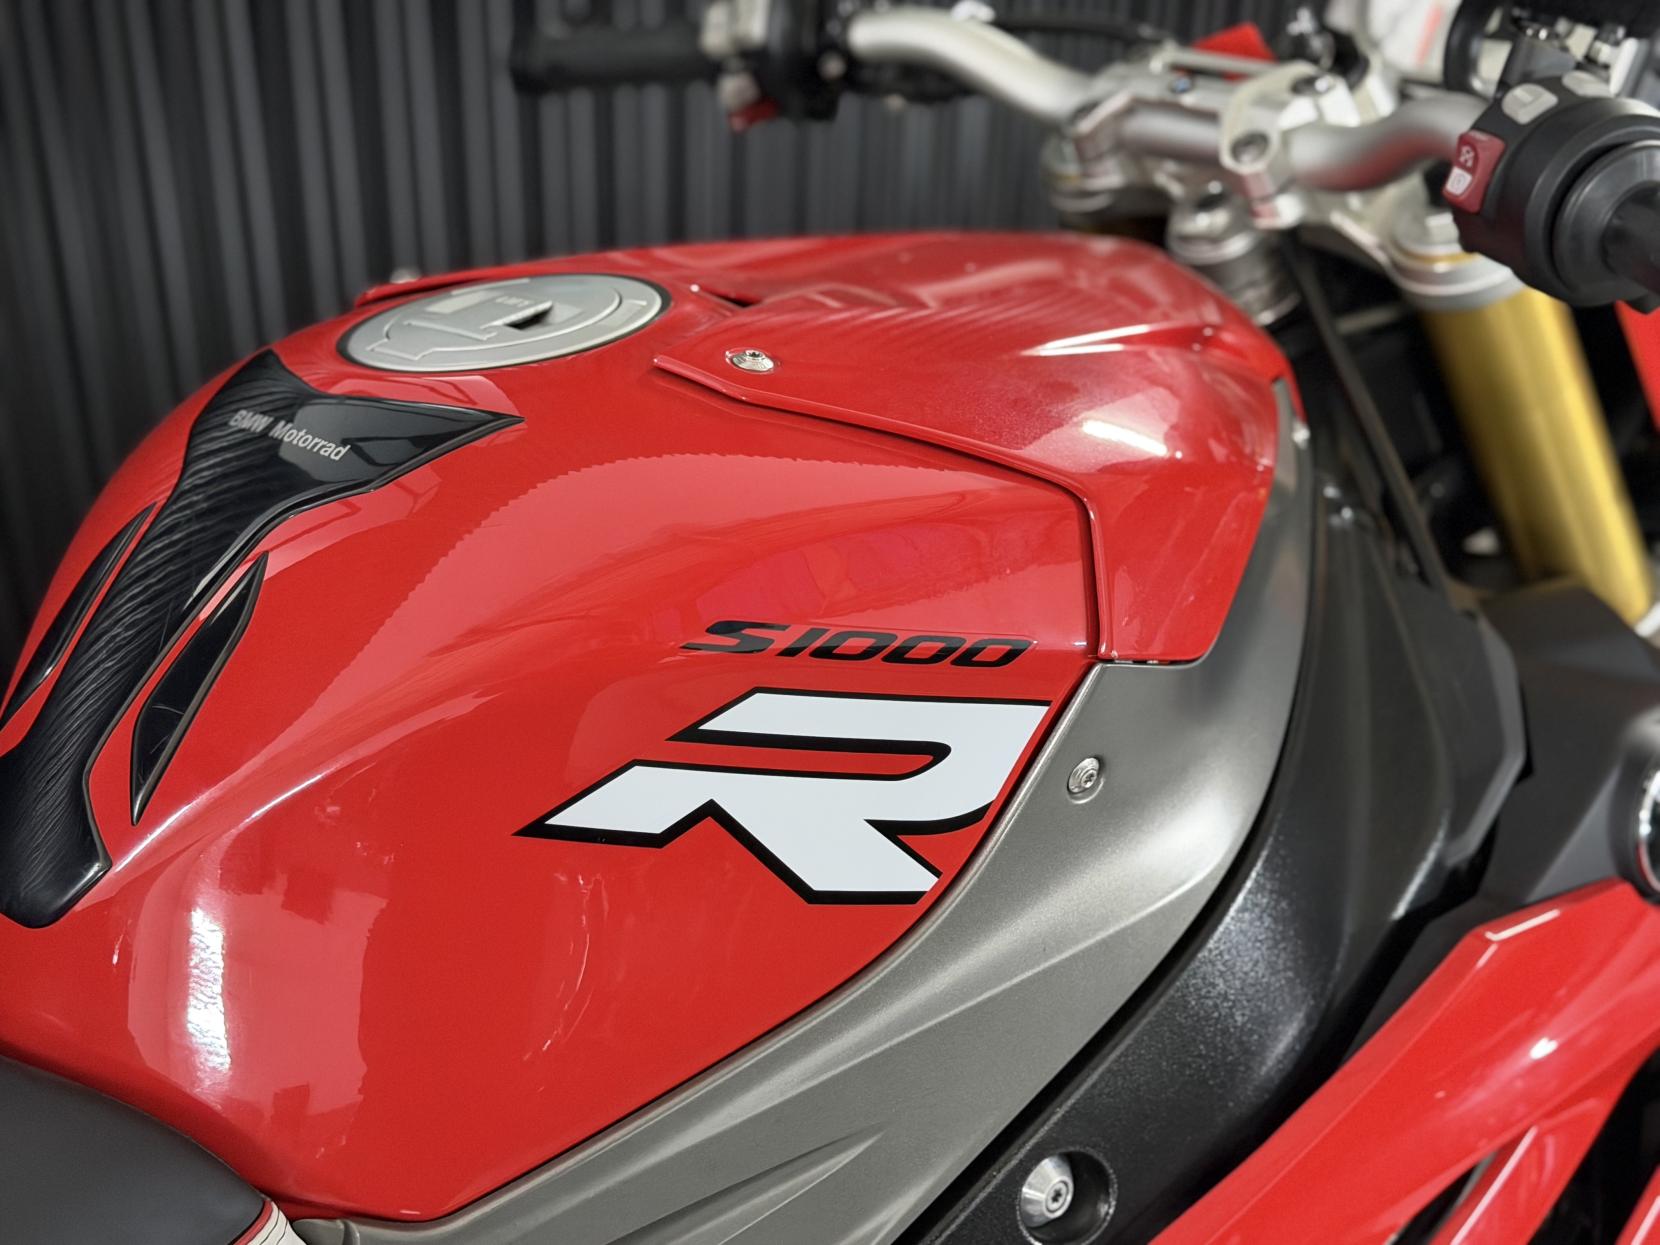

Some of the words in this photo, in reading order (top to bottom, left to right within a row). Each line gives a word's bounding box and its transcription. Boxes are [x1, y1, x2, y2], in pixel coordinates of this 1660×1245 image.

[228, 409, 275, 432] BMW
[268, 420, 351, 461] Motorrad
[512, 687, 1052, 905] R
